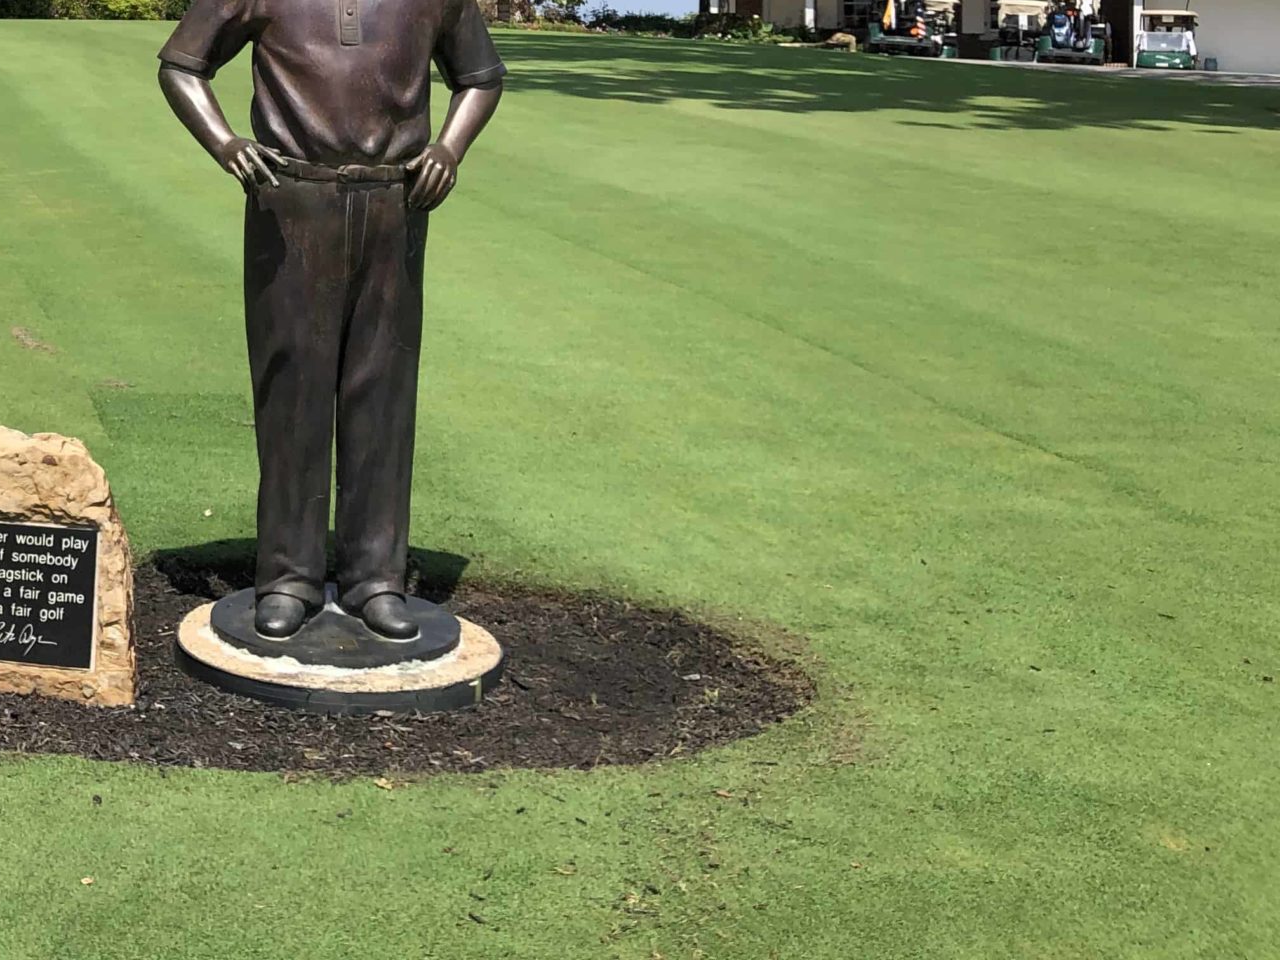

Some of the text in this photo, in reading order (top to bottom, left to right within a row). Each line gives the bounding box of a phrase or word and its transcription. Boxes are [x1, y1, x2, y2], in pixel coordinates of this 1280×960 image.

[15, 533, 54, 547] would
[61, 536, 89, 553] play
[11, 552, 79, 570] somebody
[51, 573, 68, 584] on
[3, 587, 12, 597] a
[19, 585, 41, 600] fair
[48, 591, 85, 605] game
[11, 602, 32, 617] fair
[39, 607, 64, 622] golf
